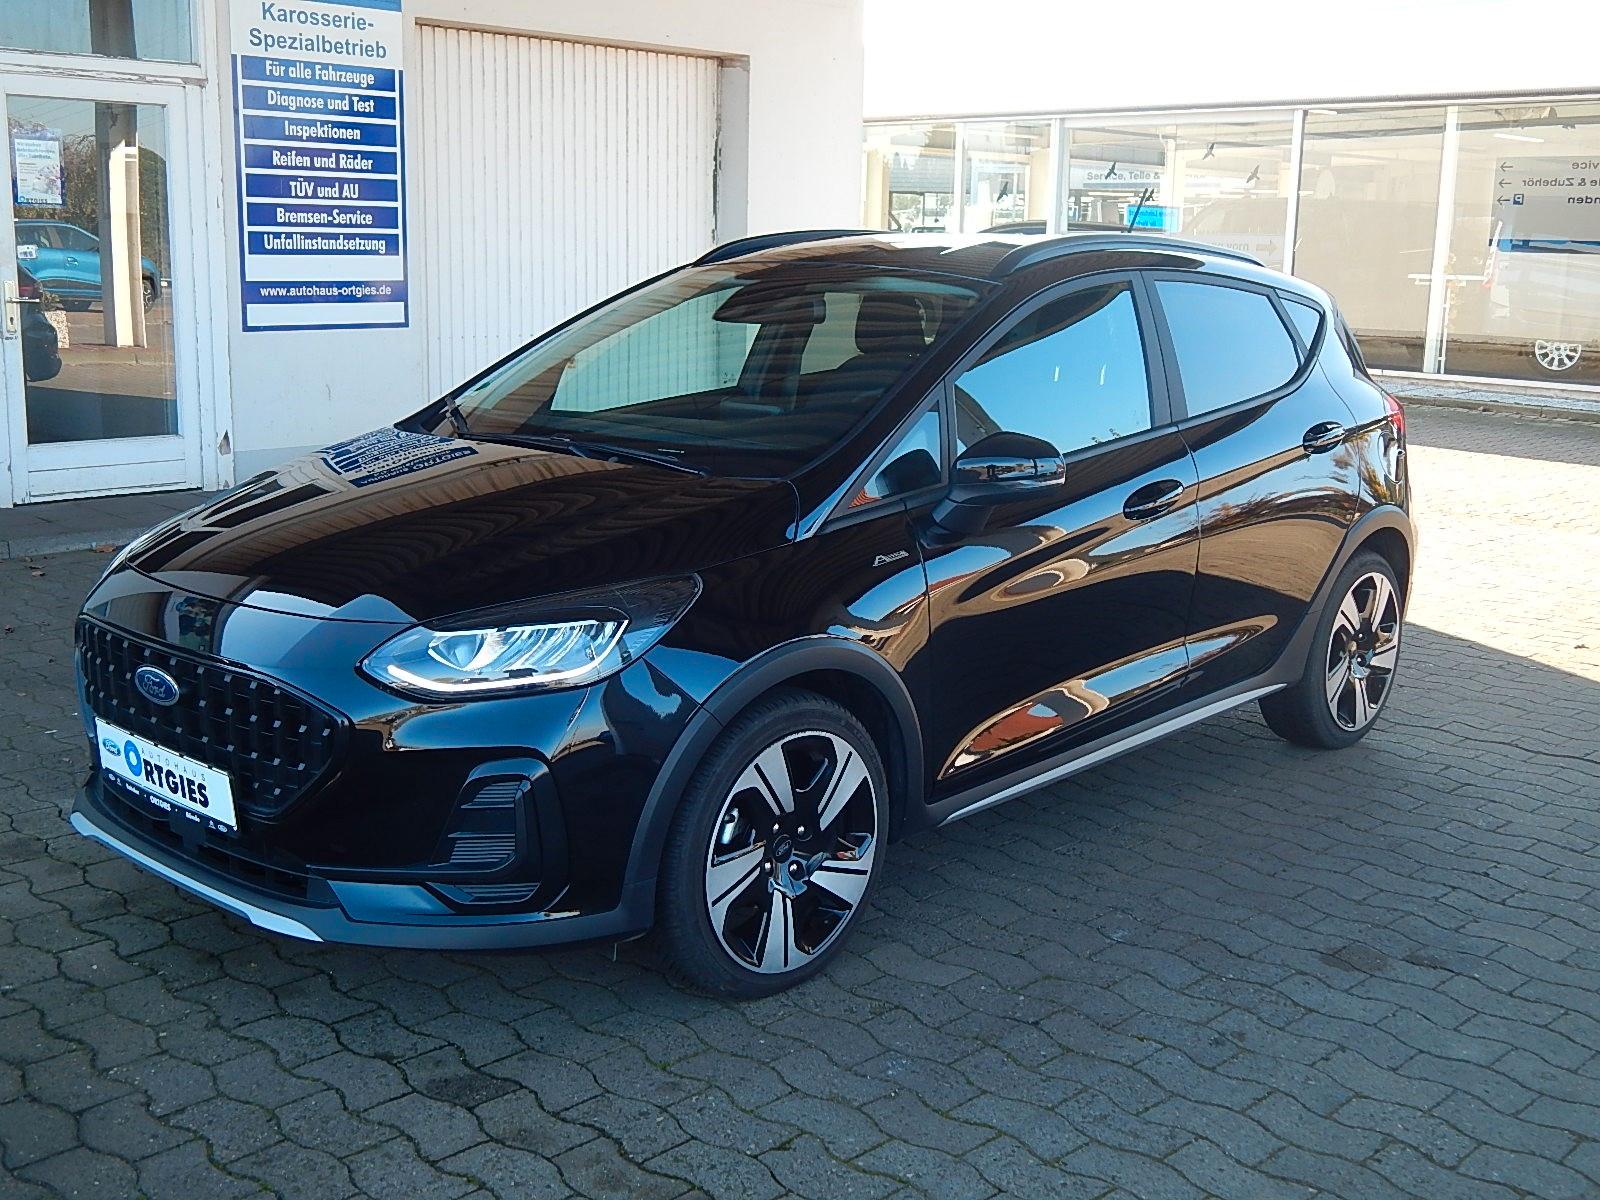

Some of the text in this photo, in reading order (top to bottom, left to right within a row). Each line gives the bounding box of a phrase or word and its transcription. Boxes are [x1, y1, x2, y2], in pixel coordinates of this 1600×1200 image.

[261, 1, 374, 31] Karosserie-
[249, 27, 387, 59] Spezialbetrieb
[265, 60, 375, 88] Für alle Fahrzeuge
[267, 89, 375, 113] Diagnose und Test
[284, 120, 361, 140] Inspektionen
[272, 150, 373, 170] Reifen und Räder
[1087, 172, 1126, 181] Serce,
[289, 178, 359, 198] TÜV und AU
[276, 207, 373, 225] Bremsen-Service
[263, 233, 386, 254] Unfallinstandsetzung
[260, 284, 392, 298] www.autohaus-ortgies.de
[123, 739, 210, 809] ORTGIES
